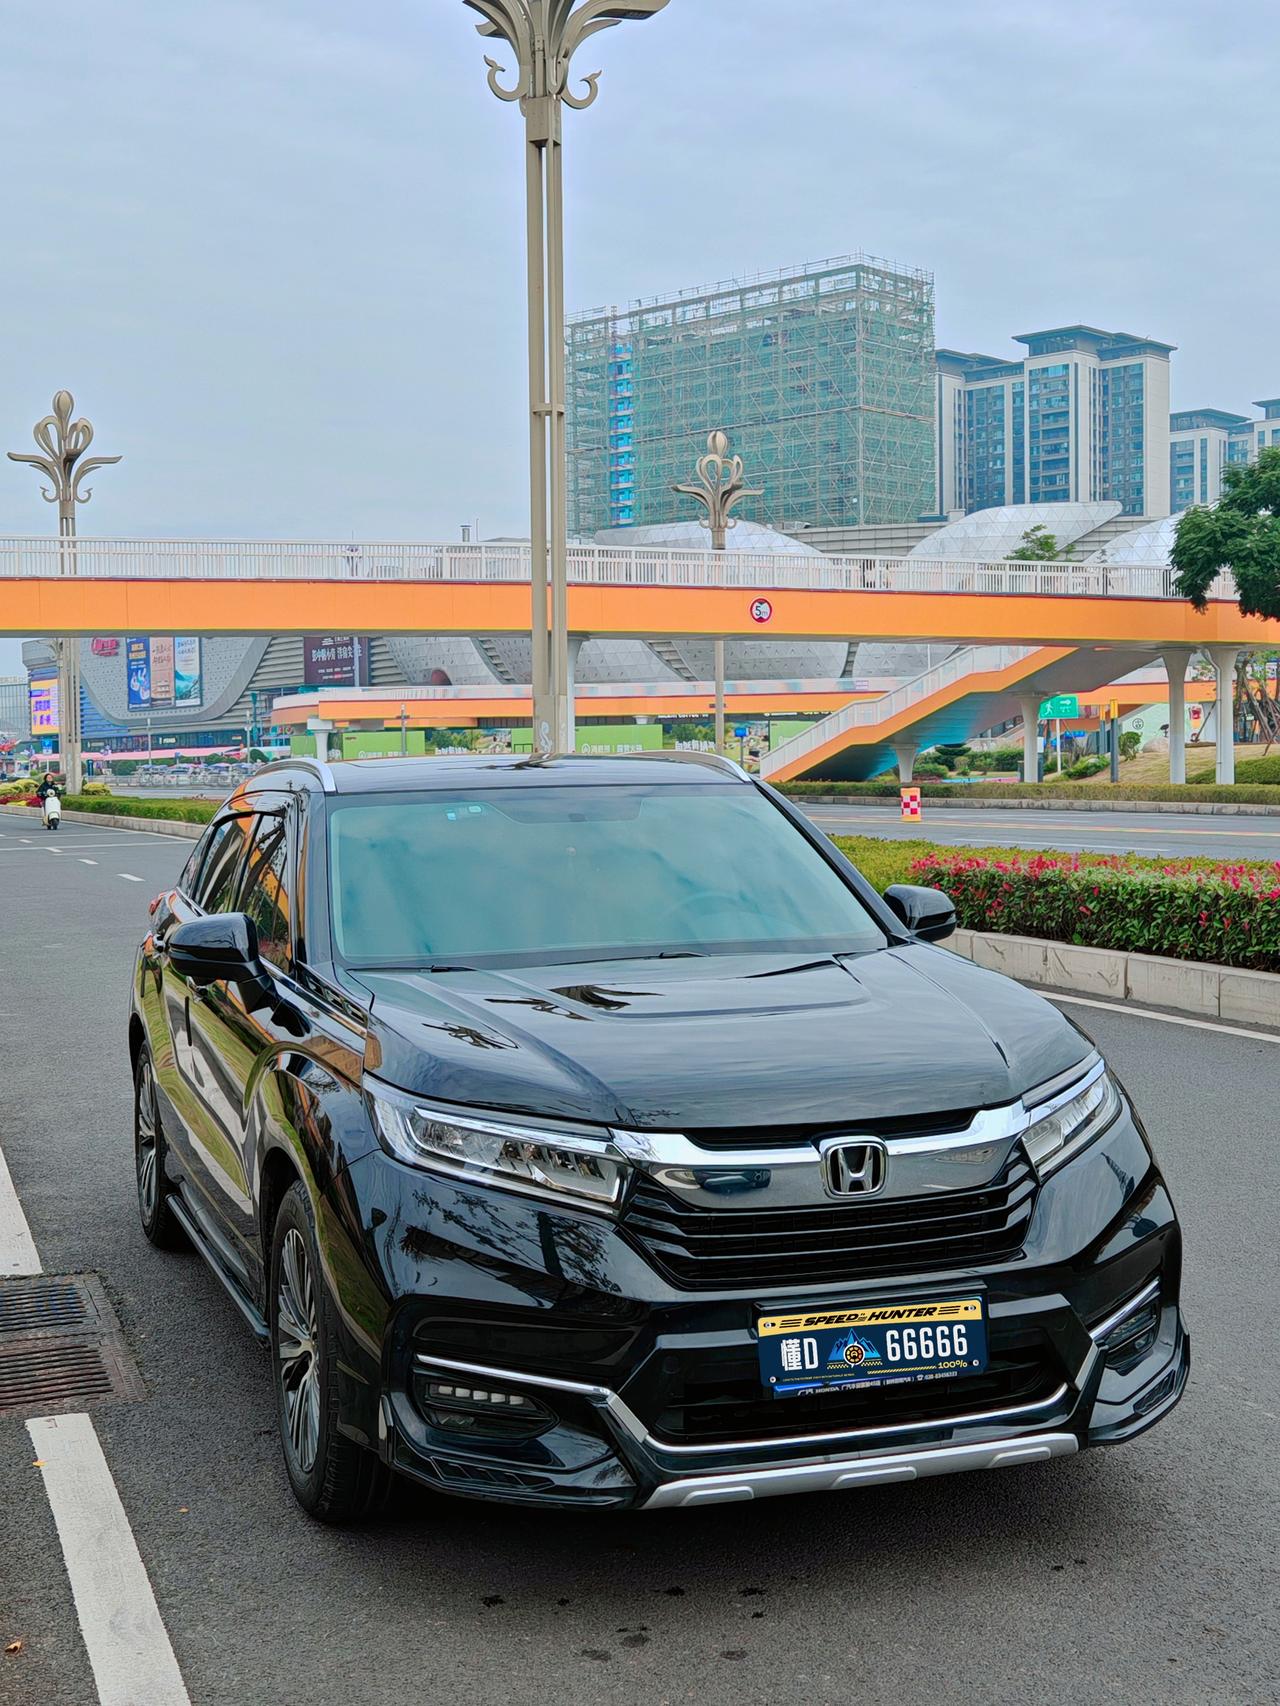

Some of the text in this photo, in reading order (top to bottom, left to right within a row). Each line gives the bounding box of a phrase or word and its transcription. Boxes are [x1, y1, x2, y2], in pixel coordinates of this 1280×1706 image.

[803, 1307, 938, 1326] SPEED HUNTER
[885, 1324, 968, 1361] 66666
[937, 1359, 968, 1370] 100%
[815, 1386, 840, 1394] HONDA
